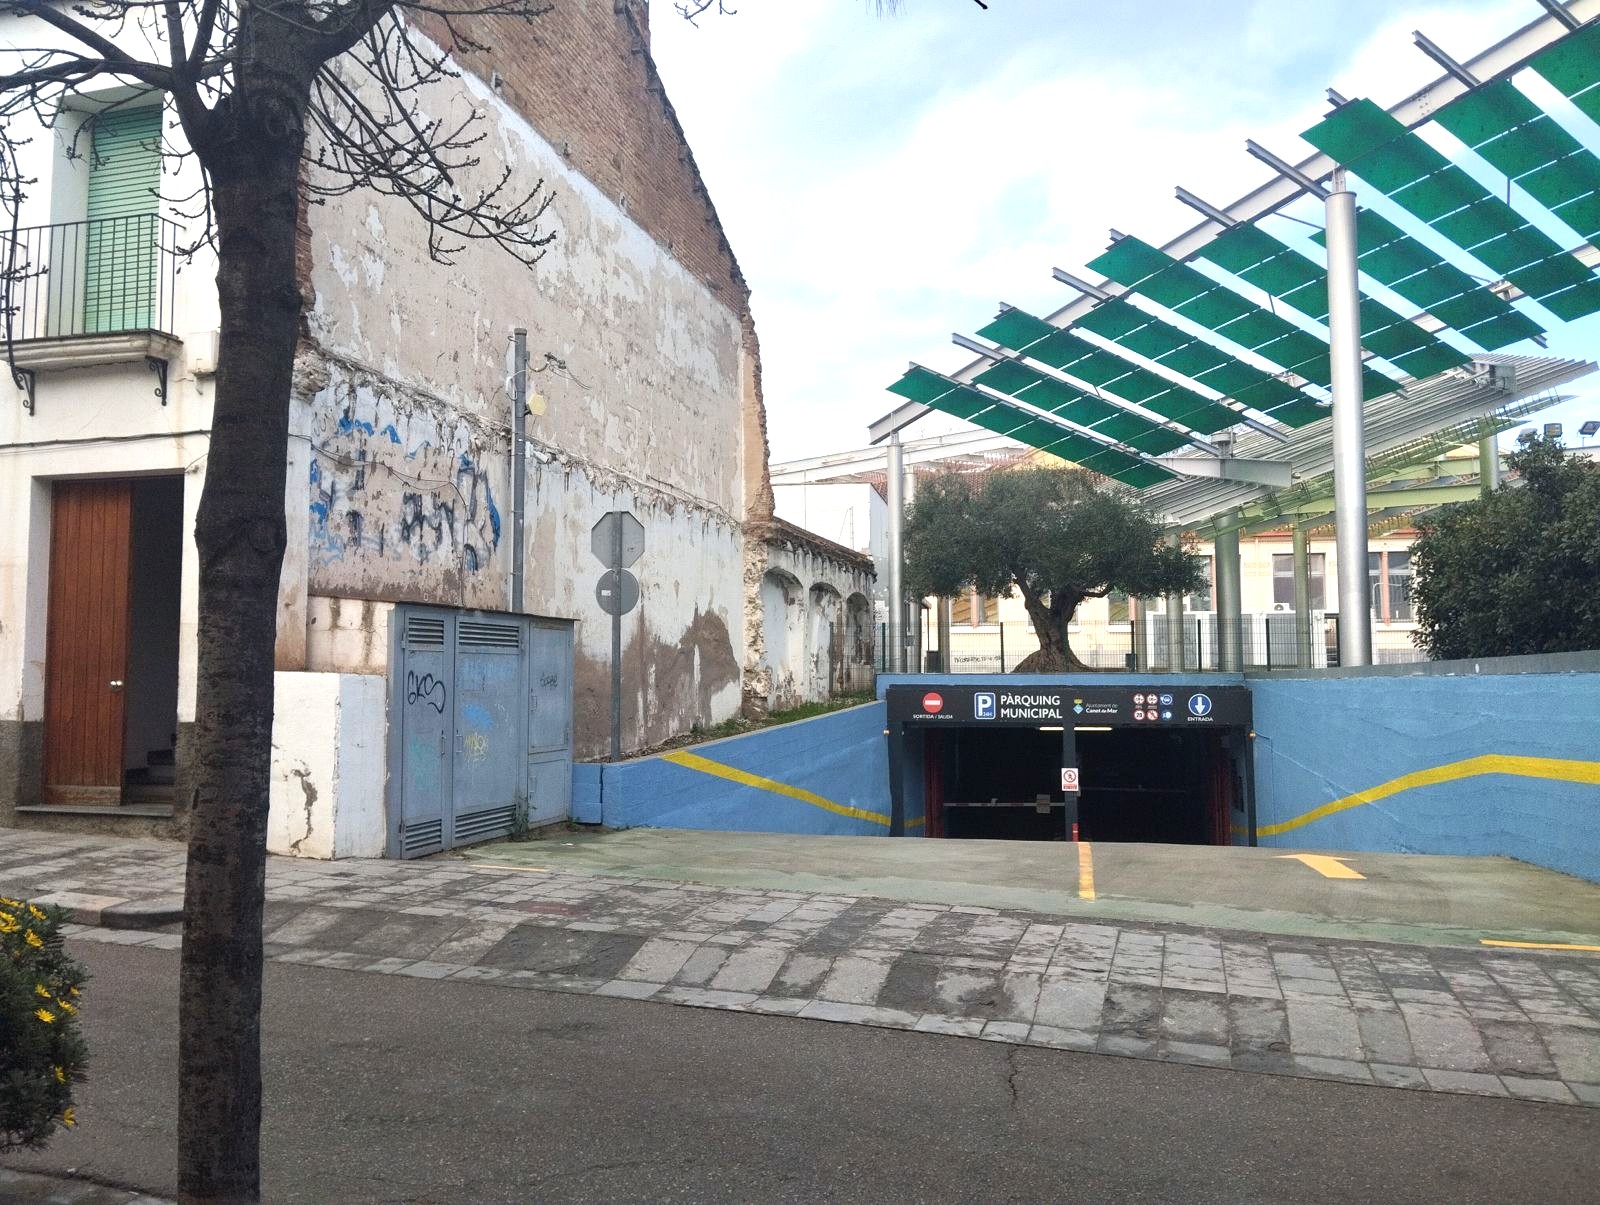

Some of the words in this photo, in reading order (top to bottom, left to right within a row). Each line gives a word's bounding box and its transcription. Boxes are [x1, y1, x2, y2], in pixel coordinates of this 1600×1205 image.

[978, 695, 992, 716] P
[1000, 692, 1061, 707] PÀRQUING
[1000, 708, 1063, 719] MUNICIPAL
